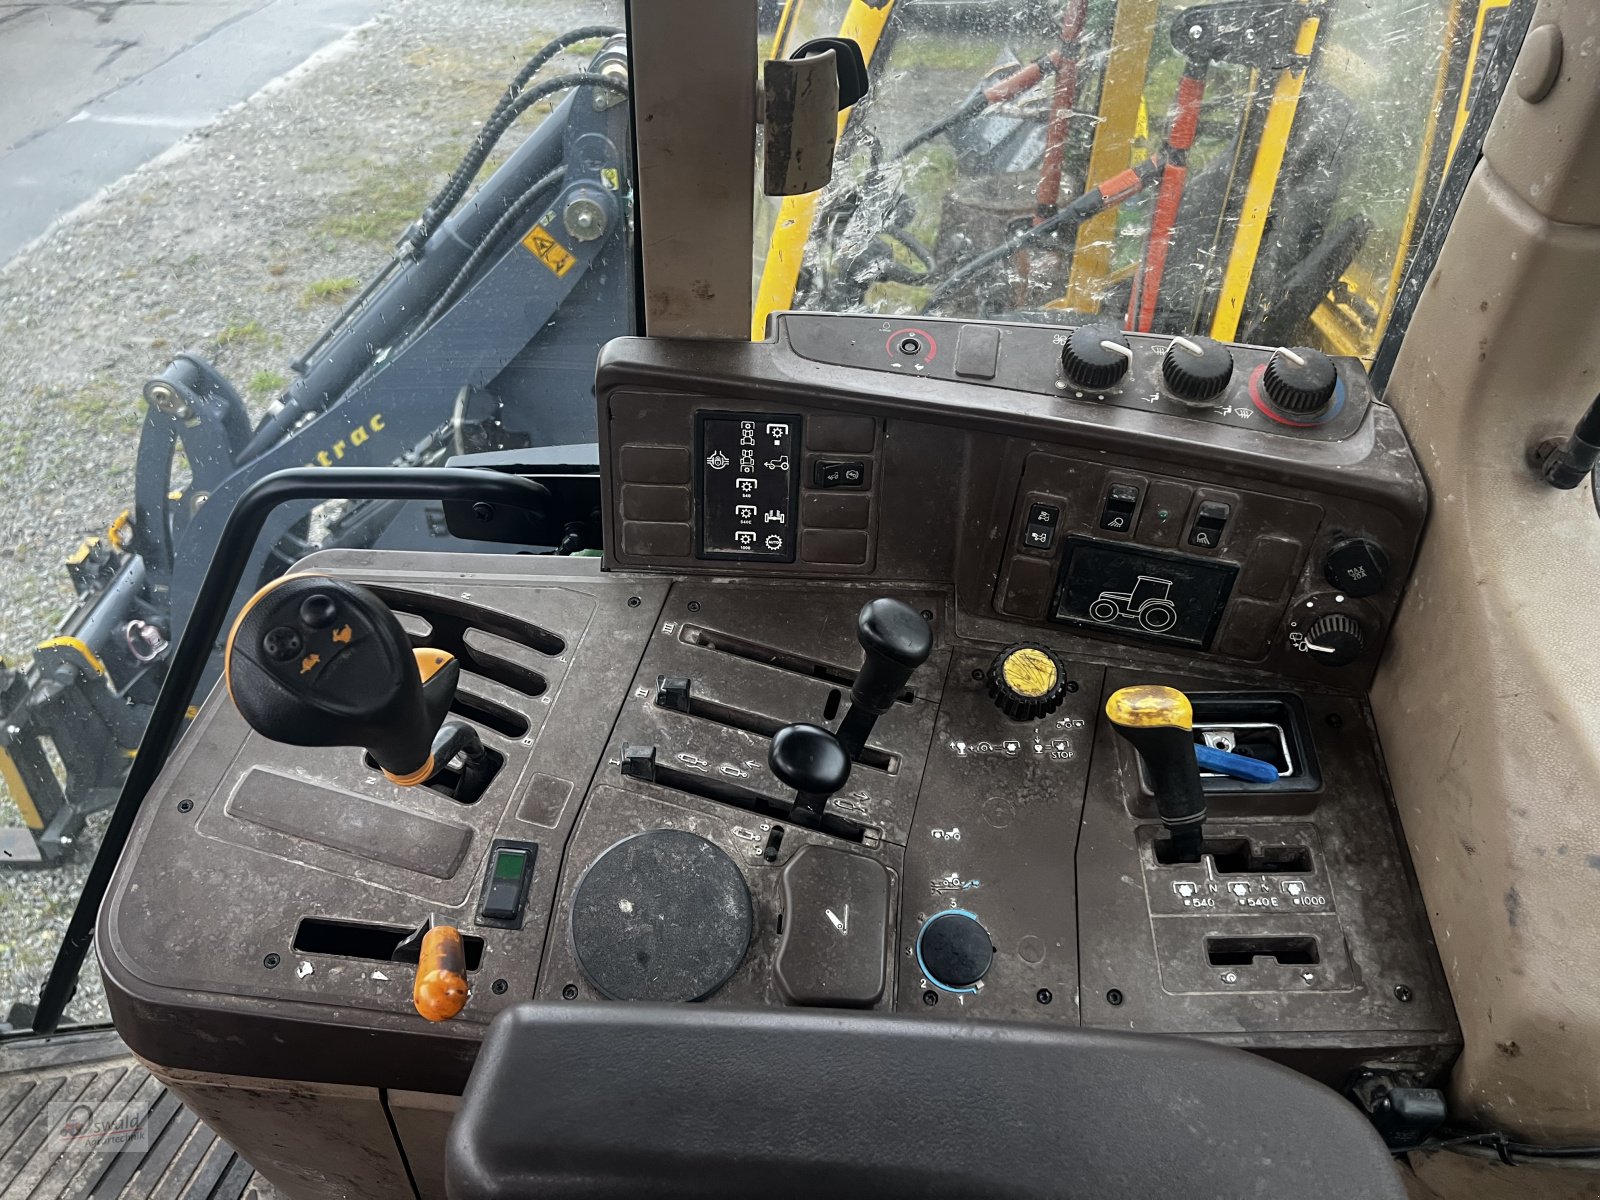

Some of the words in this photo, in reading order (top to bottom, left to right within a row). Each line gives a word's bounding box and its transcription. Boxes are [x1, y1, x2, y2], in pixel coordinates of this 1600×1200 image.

[1051, 751, 1074, 759] STOP
[1209, 884, 1218, 893] N
[1193, 898, 1215, 907] 540
[1300, 896, 1326, 905] 1000
[920, 979, 927, 988] 2
